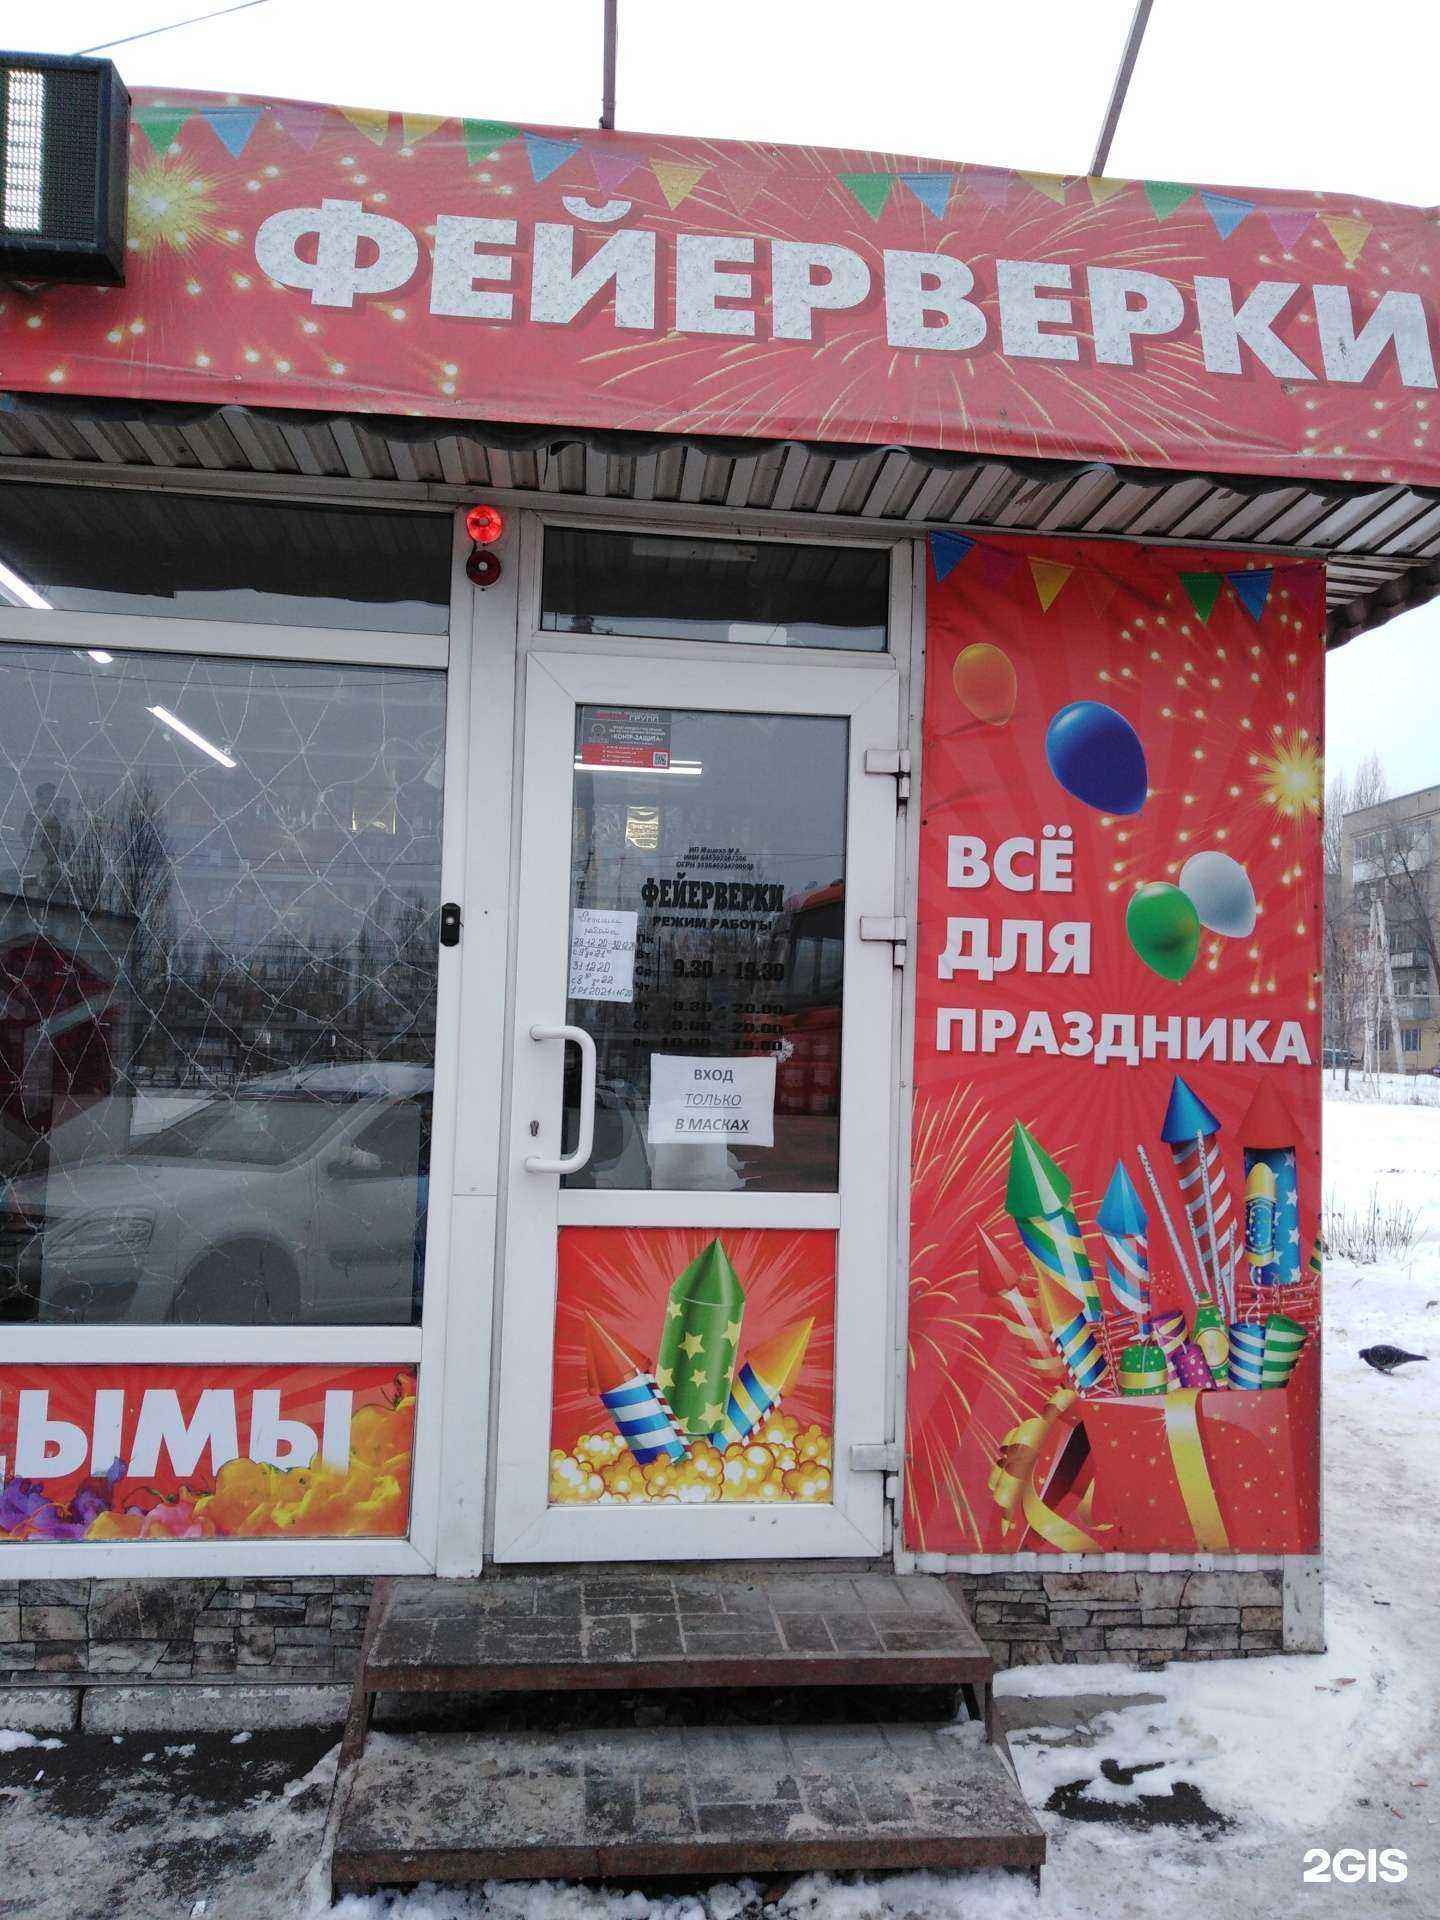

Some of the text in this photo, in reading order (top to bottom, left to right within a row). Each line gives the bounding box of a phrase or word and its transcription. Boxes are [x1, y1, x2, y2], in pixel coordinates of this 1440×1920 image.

[254, 196, 1438, 388] ФЕЙЕРВЕРКИ
[947, 824, 1074, 893] ВСЁ
[641, 872, 785, 912] ФЕЙЕРВЕРКИ
[653, 916, 773, 931] РЕЖИМ РАБОТЫ
[938, 917, 1092, 981] ДЛЯ
[936, 1008, 1312, 1066] ПРАЗДНИКА
[684, 1093, 743, 1107] ТОЛЬКО
[694, 1069, 734, 1083] ВХОД
[675, 1119, 751, 1132] В МАСКАХ
[0, 1388, 354, 1480] ЫМЫ
